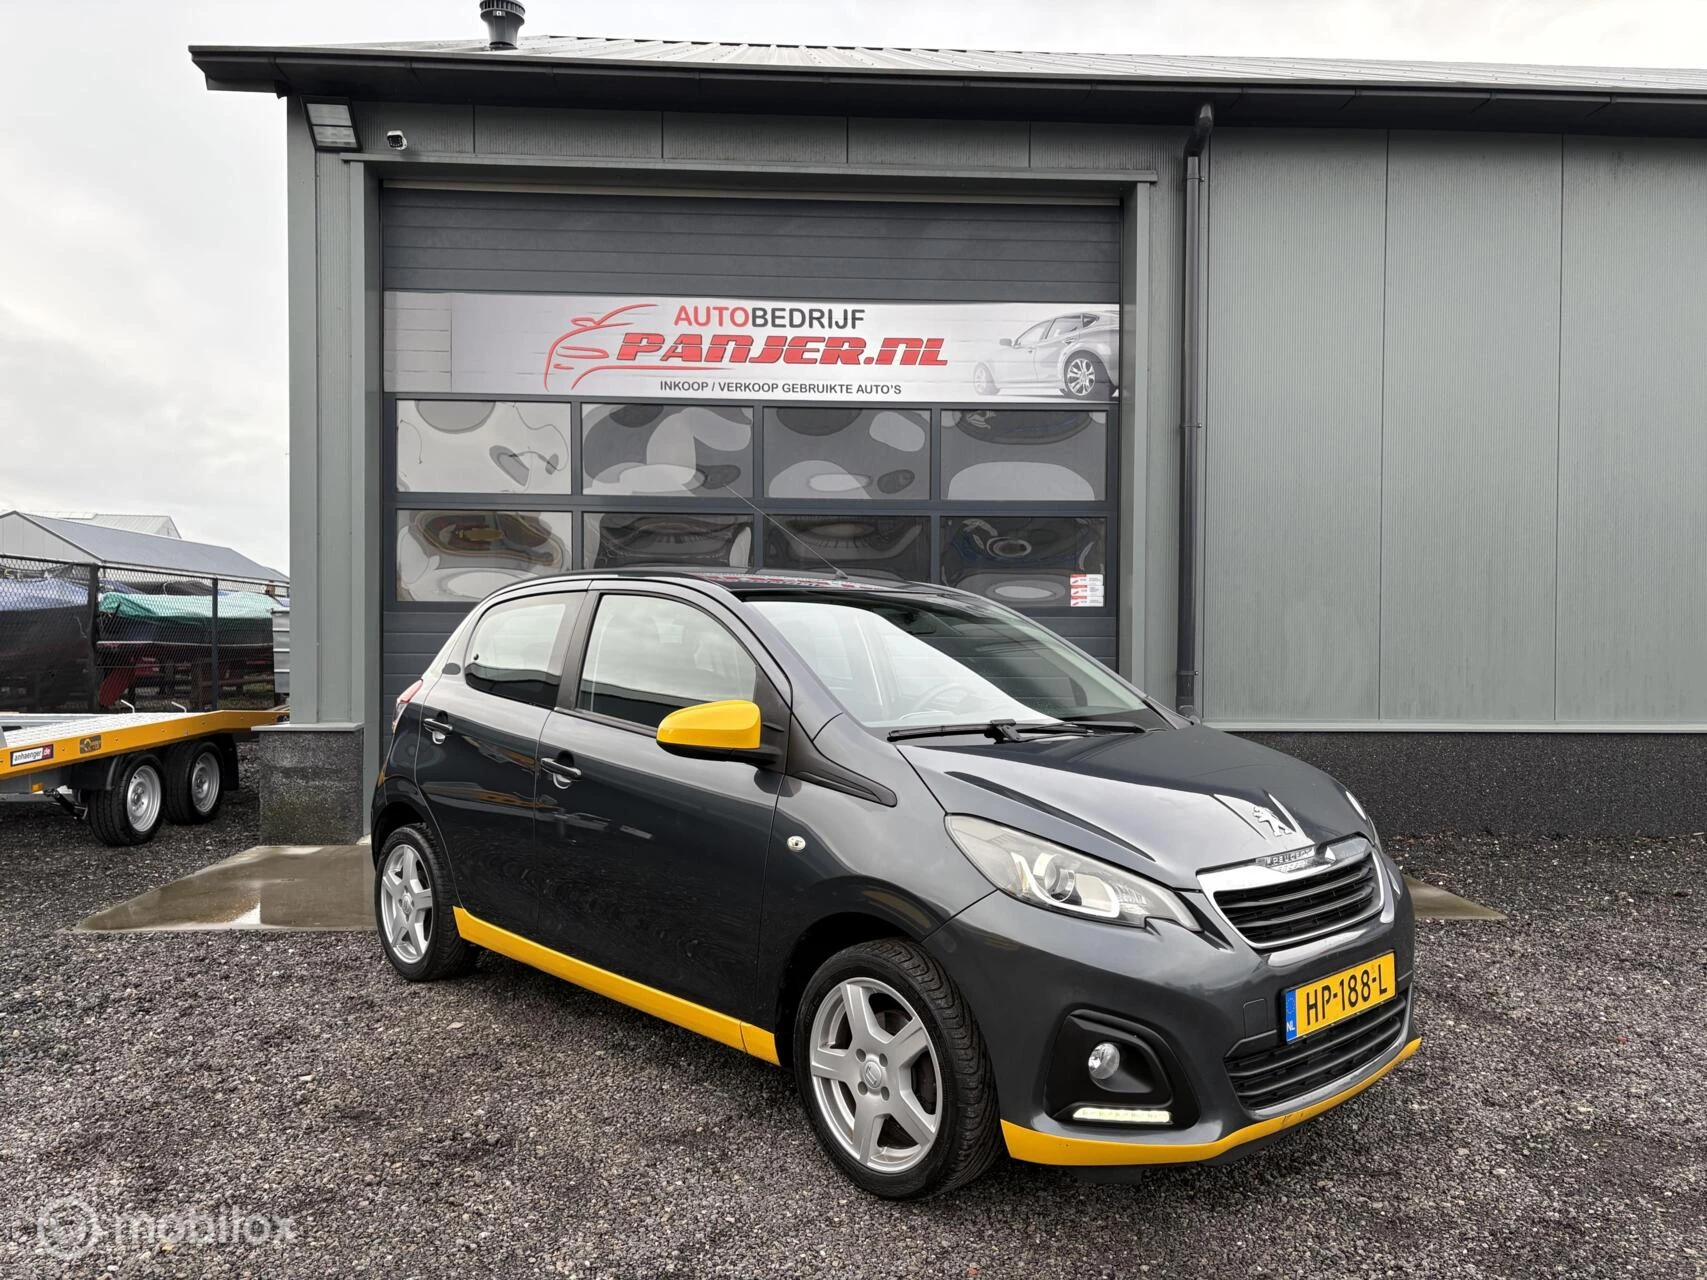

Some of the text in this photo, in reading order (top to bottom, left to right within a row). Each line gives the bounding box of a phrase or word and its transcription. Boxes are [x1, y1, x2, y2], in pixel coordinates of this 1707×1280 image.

[673, 305, 866, 330] AUTOBEDRIJF
[616, 332, 949, 366] PANJER.NL
[660, 380, 709, 391] INKOOP
[718, 382, 779, 393] VERKOOP
[782, 383, 854, 394] GEBRUIKTE
[856, 384, 902, 395] AUTO'S
[1306, 964, 1388, 1026] HP-188-L
[1286, 1020, 1296, 1033] NL
